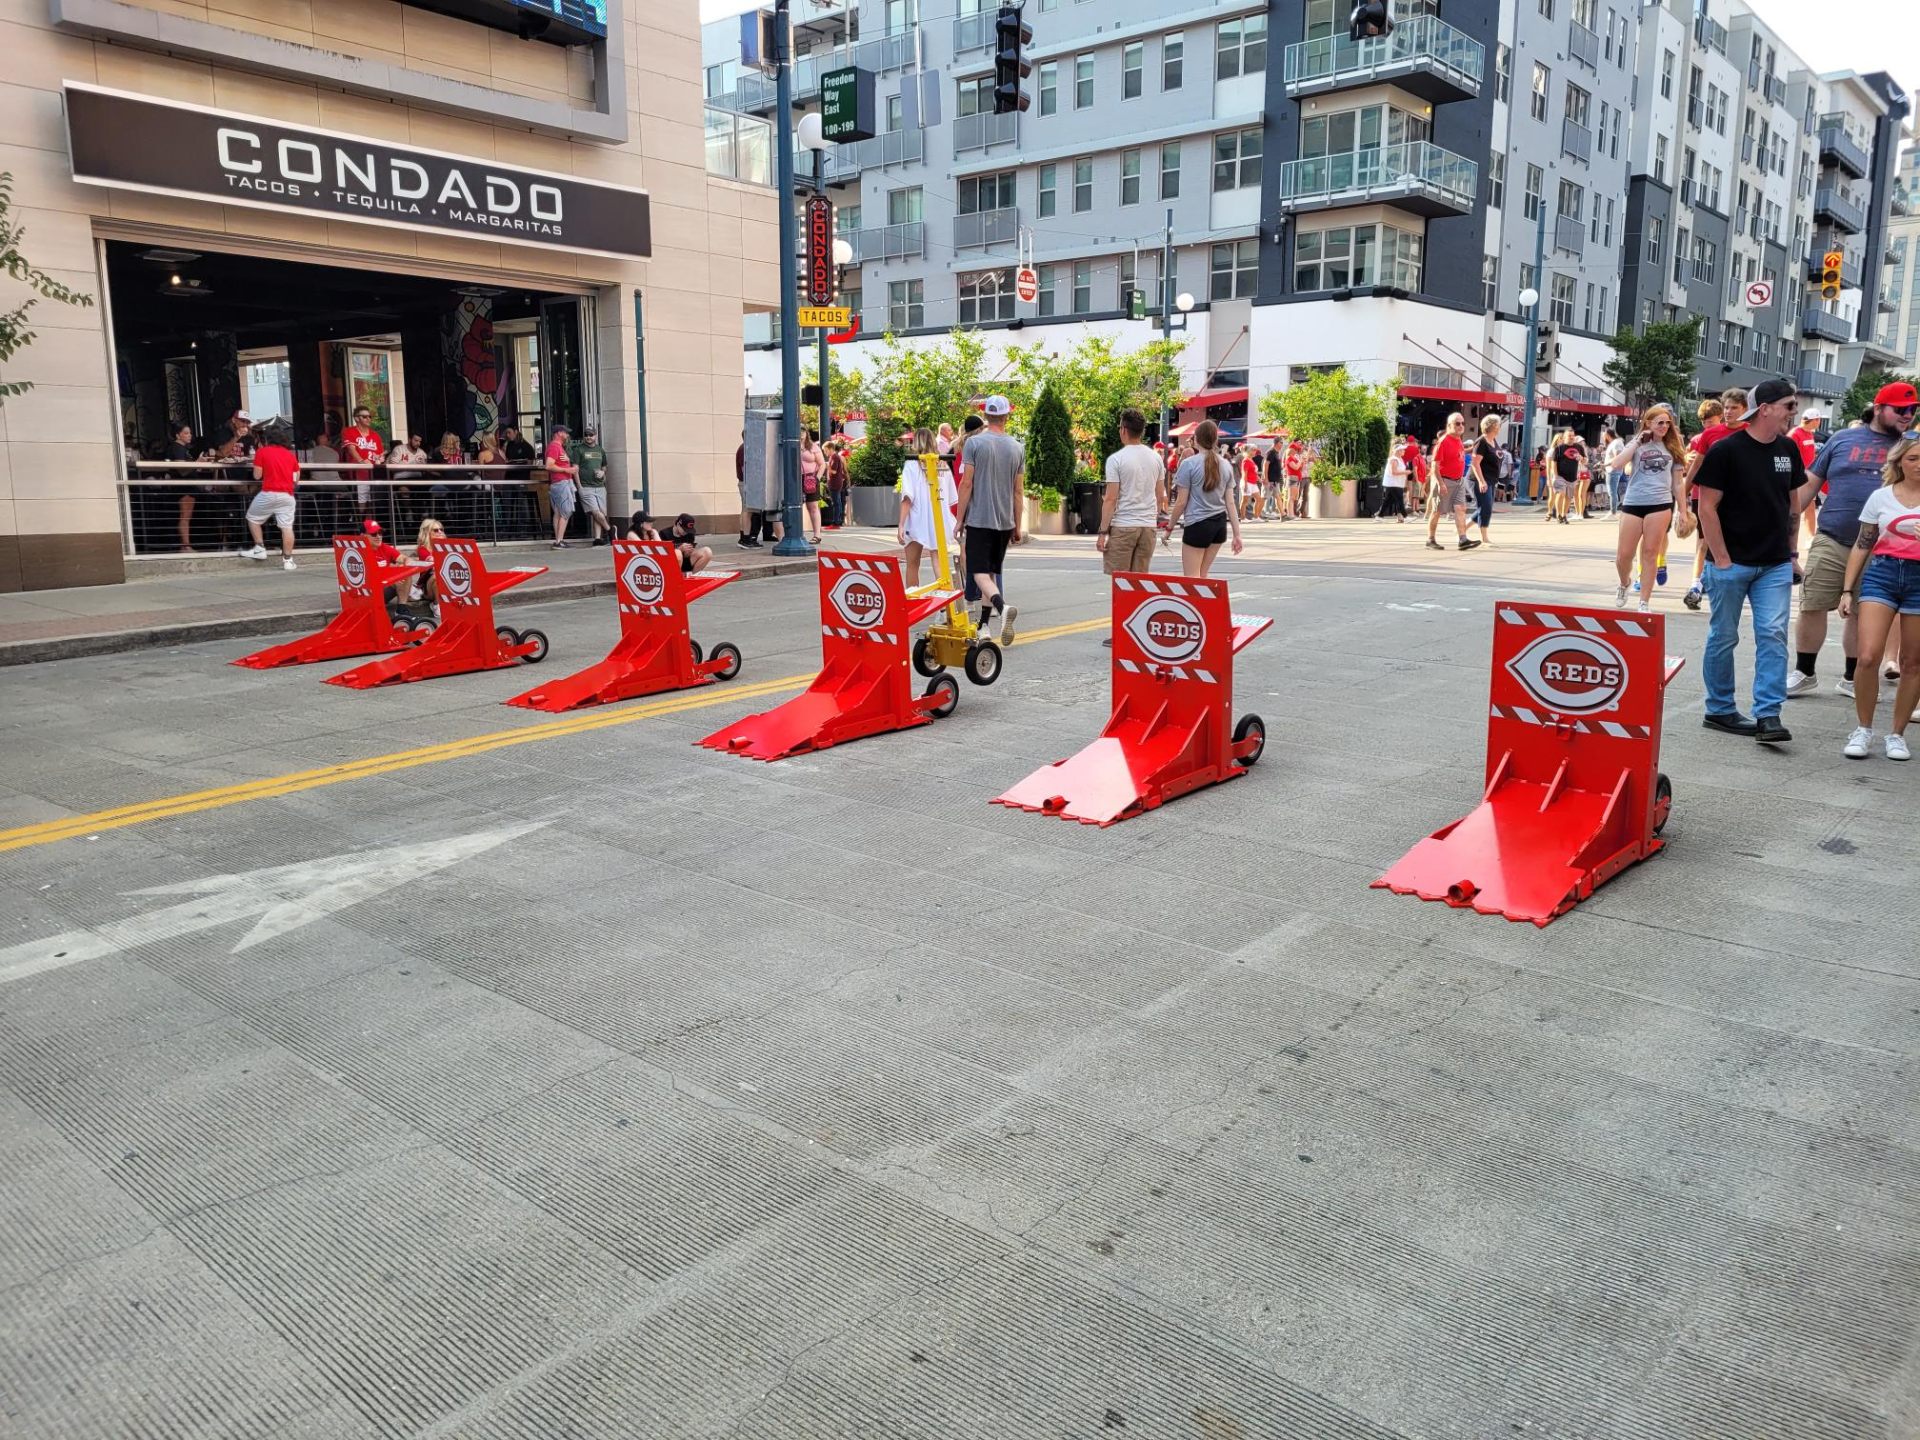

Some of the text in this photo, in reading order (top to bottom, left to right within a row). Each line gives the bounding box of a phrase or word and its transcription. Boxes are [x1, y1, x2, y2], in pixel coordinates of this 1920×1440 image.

[824, 73, 855, 88] Freedom
[824, 90, 840, 102] Way
[824, 103, 840, 115] East
[824, 120, 855, 136] 100-199
[216, 127, 564, 222] CONDADO
[224, 173, 563, 236] TACOS TEQUILA MARGARITAS
[813, 211, 827, 292] CONDADO
[803, 310, 843, 322] TACOS
[1849, 447, 1888, 463] RED
[347, 562, 363, 573] REDS
[449, 569, 470, 580] REDS
[634, 574, 662, 586] REDS
[846, 592, 882, 608] REDS
[1150, 621, 1200, 640] REDS
[1544, 662, 1620, 686] REDS
